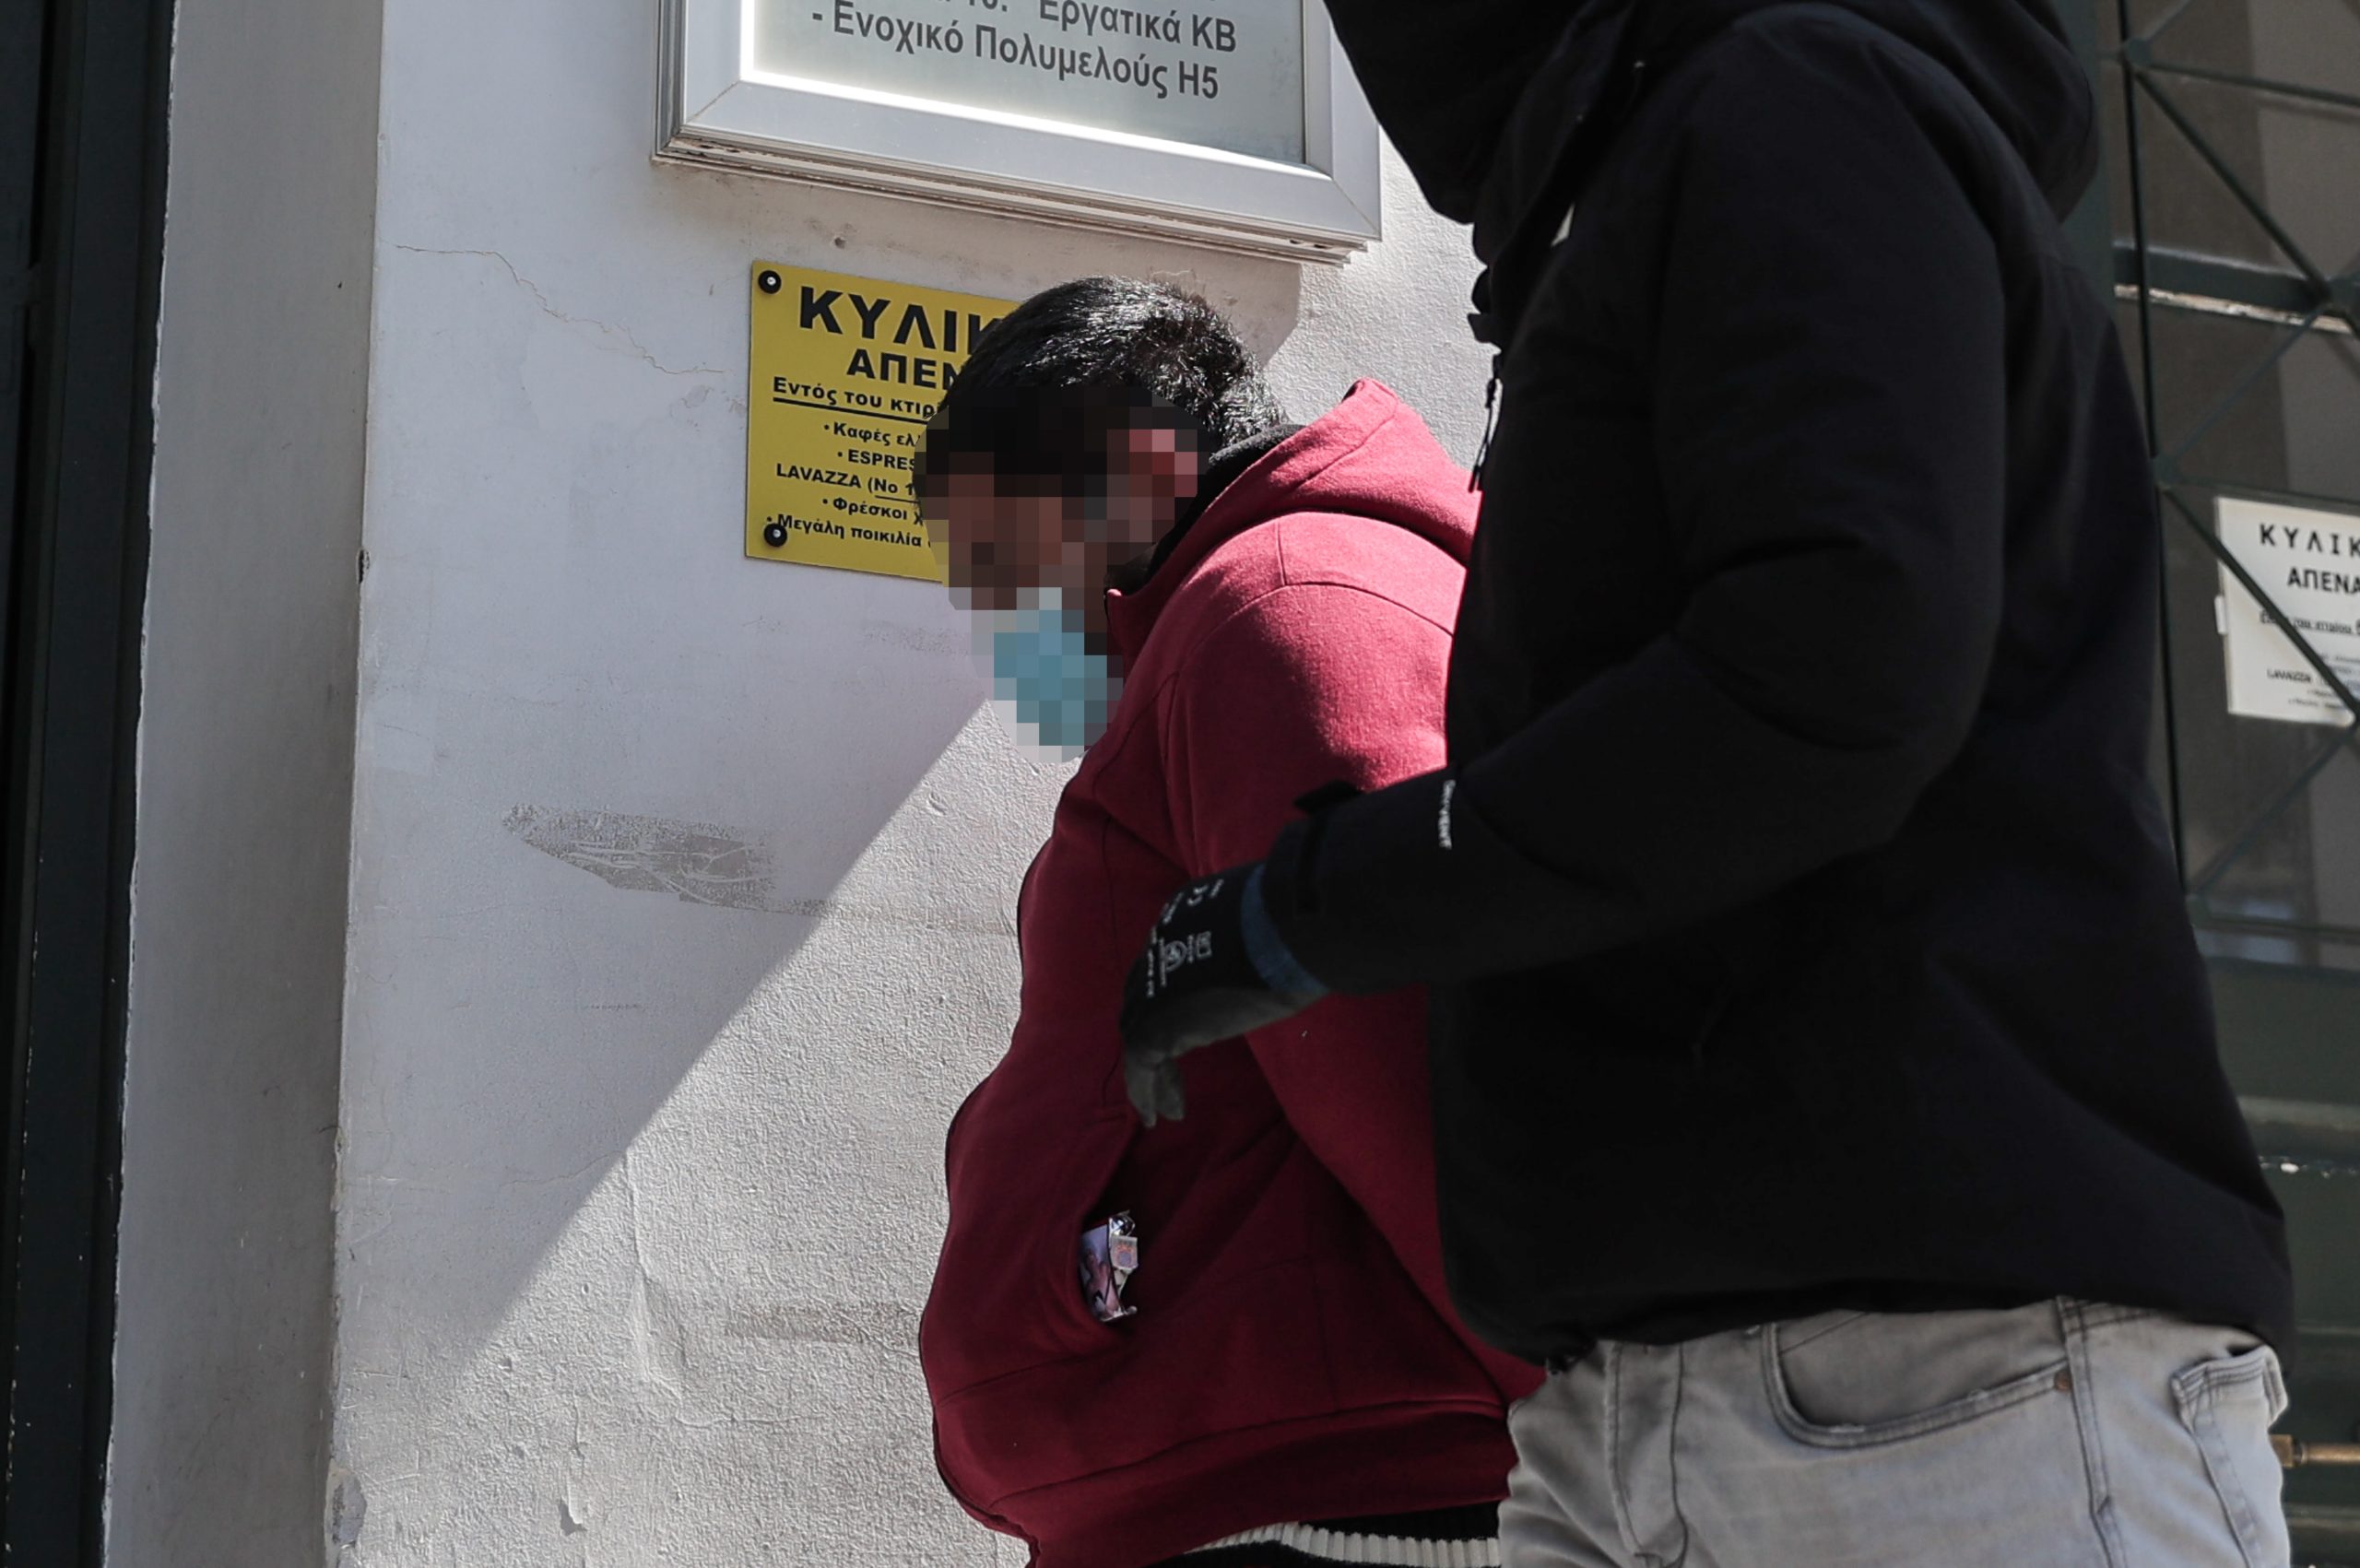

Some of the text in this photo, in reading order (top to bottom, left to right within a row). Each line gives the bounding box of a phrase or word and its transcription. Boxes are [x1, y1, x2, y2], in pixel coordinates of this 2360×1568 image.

[1040, 0, 1237, 53] Εργατικά ΚΒ
[833, 0, 963, 54] Ενοχικό
[975, 24, 1168, 99] Πολυμελούς
[1178, 60, 1219, 100] Η5
[773, 376, 837, 406] Εντός
[844, 391, 882, 408] του
[833, 421, 891, 446] Καφές
[776, 463, 862, 489] LAVAZZA
[832, 497, 907, 521] Φρέσκοι
[778, 513, 922, 548] Μεγάλη ποικιλία
